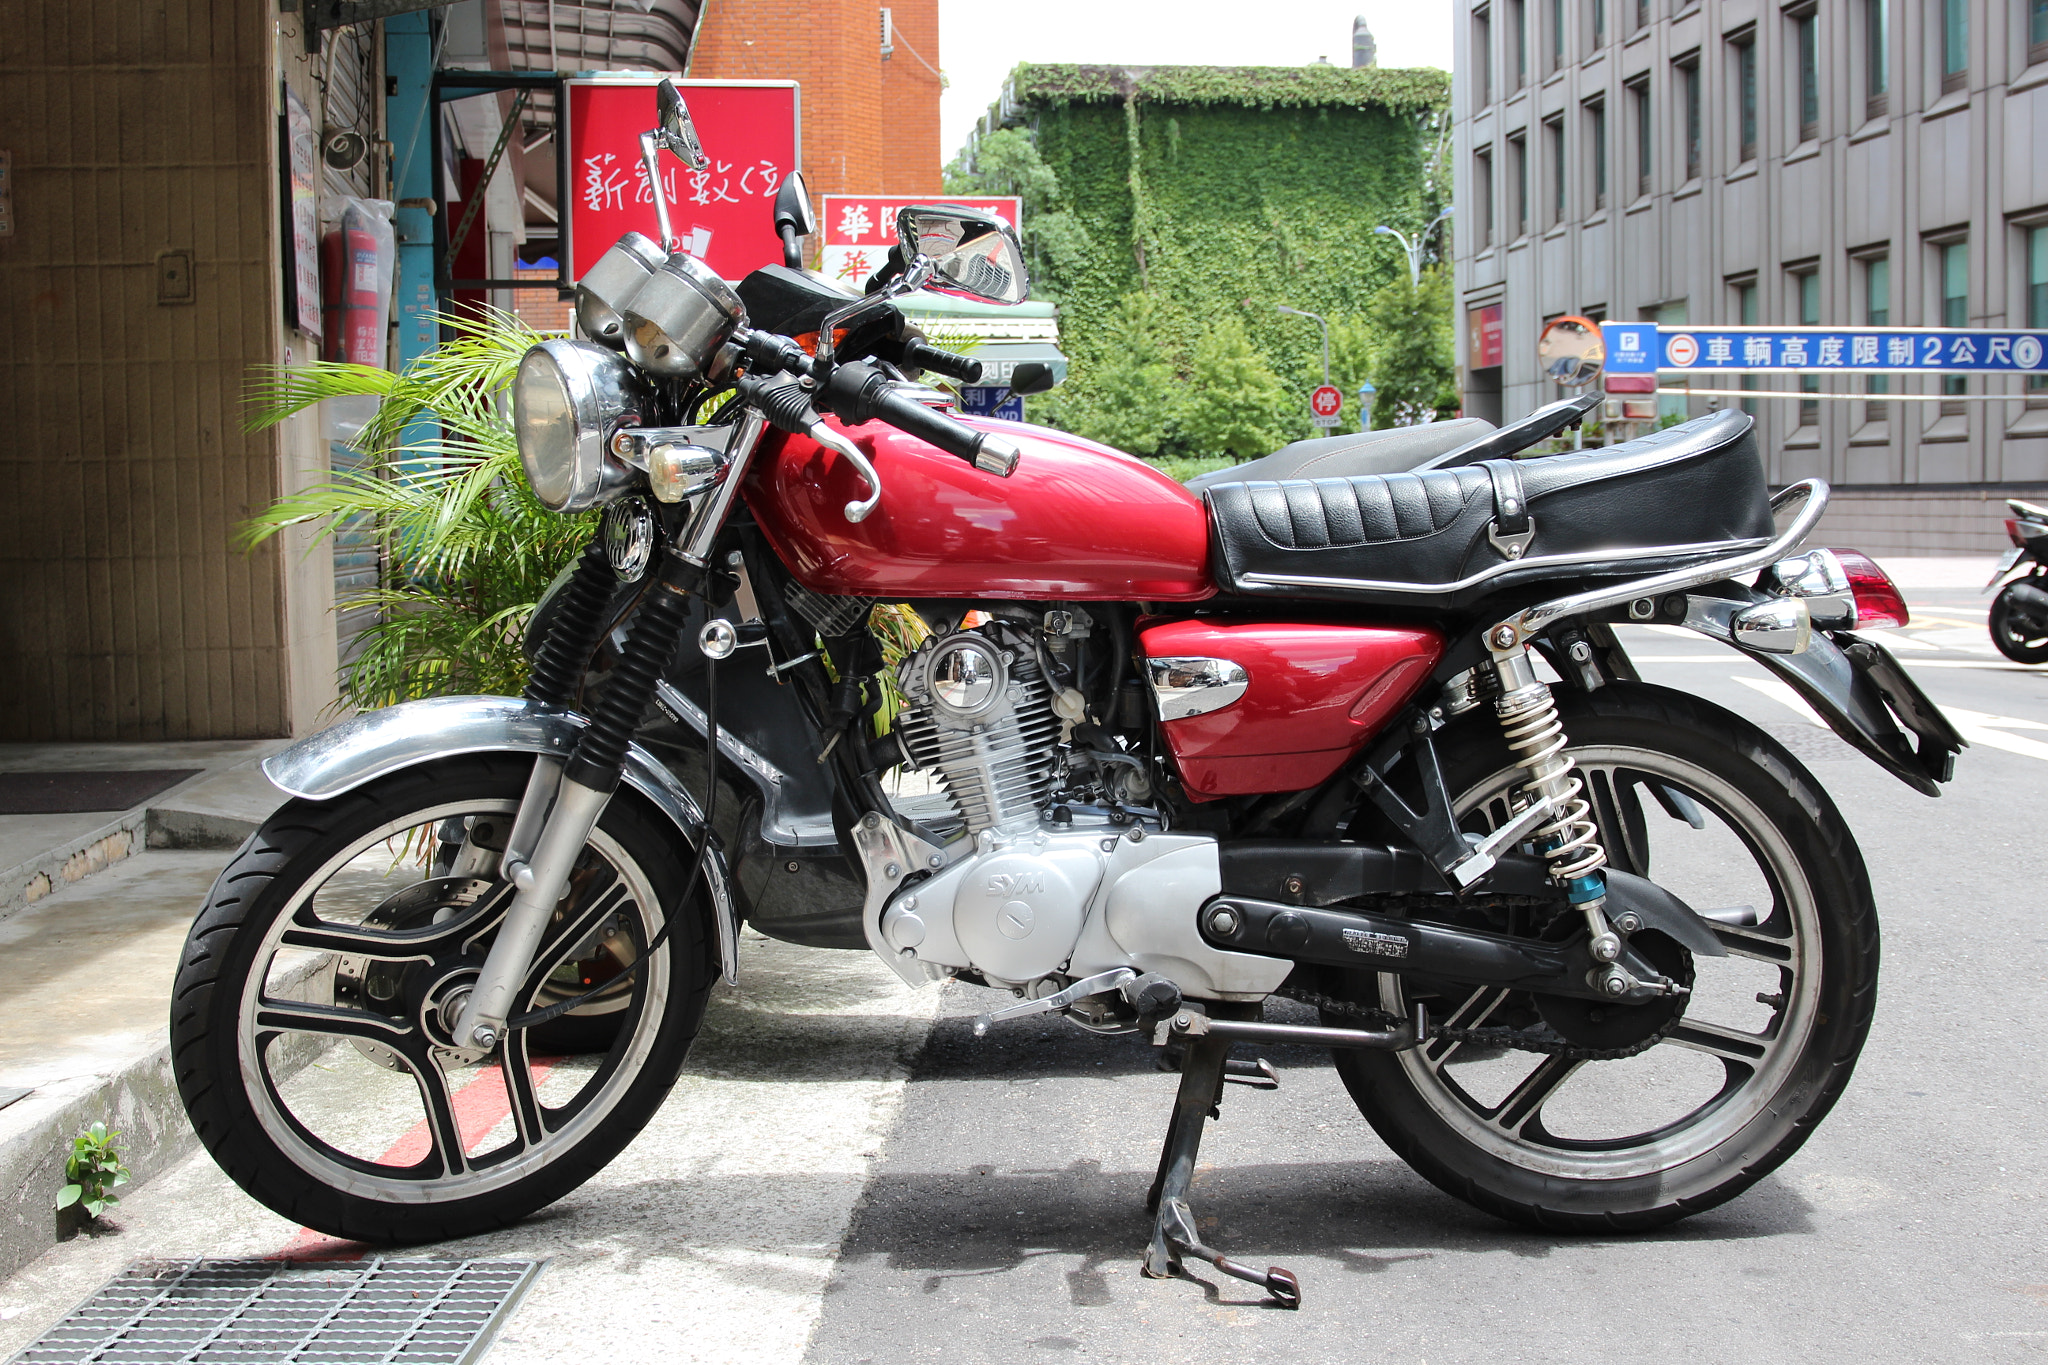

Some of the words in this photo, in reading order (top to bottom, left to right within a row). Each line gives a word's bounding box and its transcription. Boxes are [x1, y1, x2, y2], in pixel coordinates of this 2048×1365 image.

[839, 250, 872, 283] 華
[1705, 335, 2011, 366] 車輛高度限制2公尺
[1316, 391, 1337, 412] 停
[986, 871, 1046, 898] SYM
